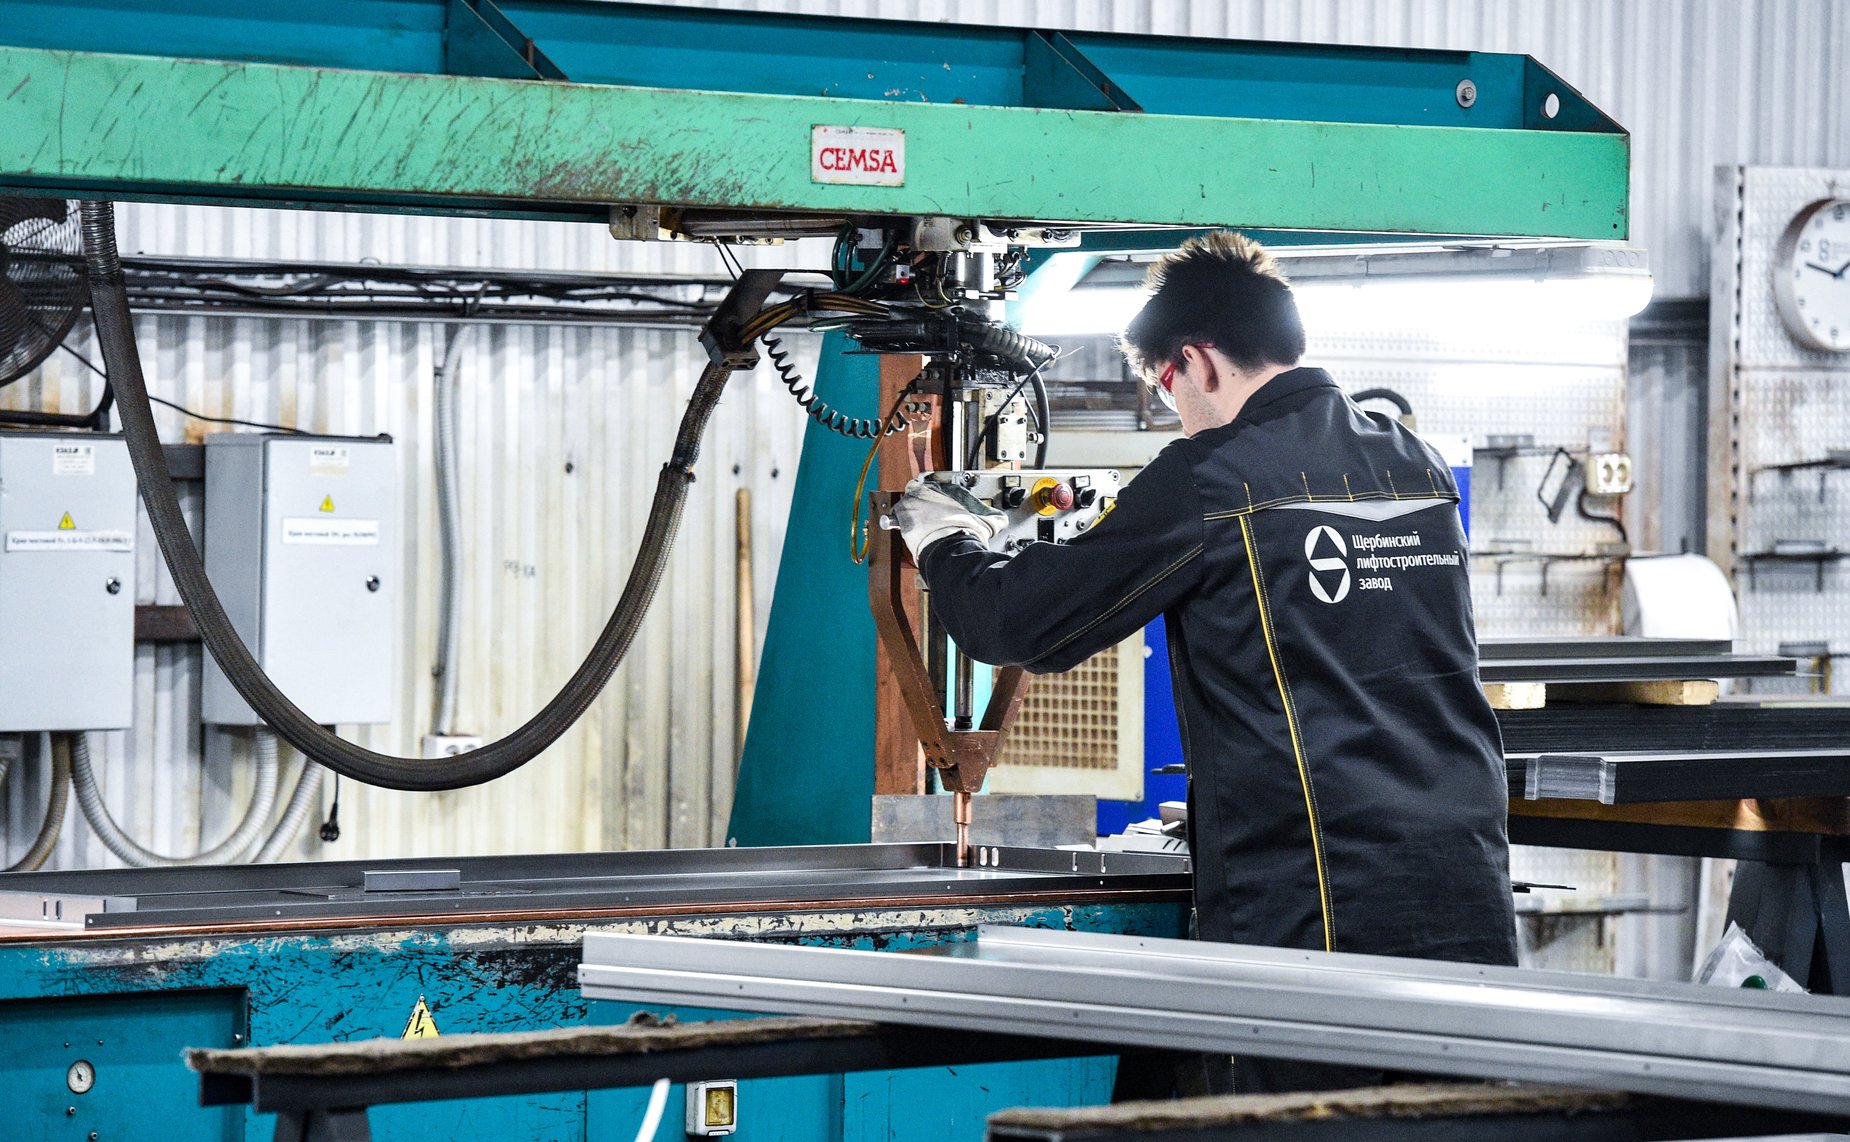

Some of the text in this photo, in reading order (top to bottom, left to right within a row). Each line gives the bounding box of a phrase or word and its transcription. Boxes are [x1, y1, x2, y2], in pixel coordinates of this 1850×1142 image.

[820, 147, 898, 173] CEMSA
[1352, 531, 1421, 551] Щербинский
[1356, 551, 1460, 572] лифтостроительный
[1358, 577, 1393, 591] завод
